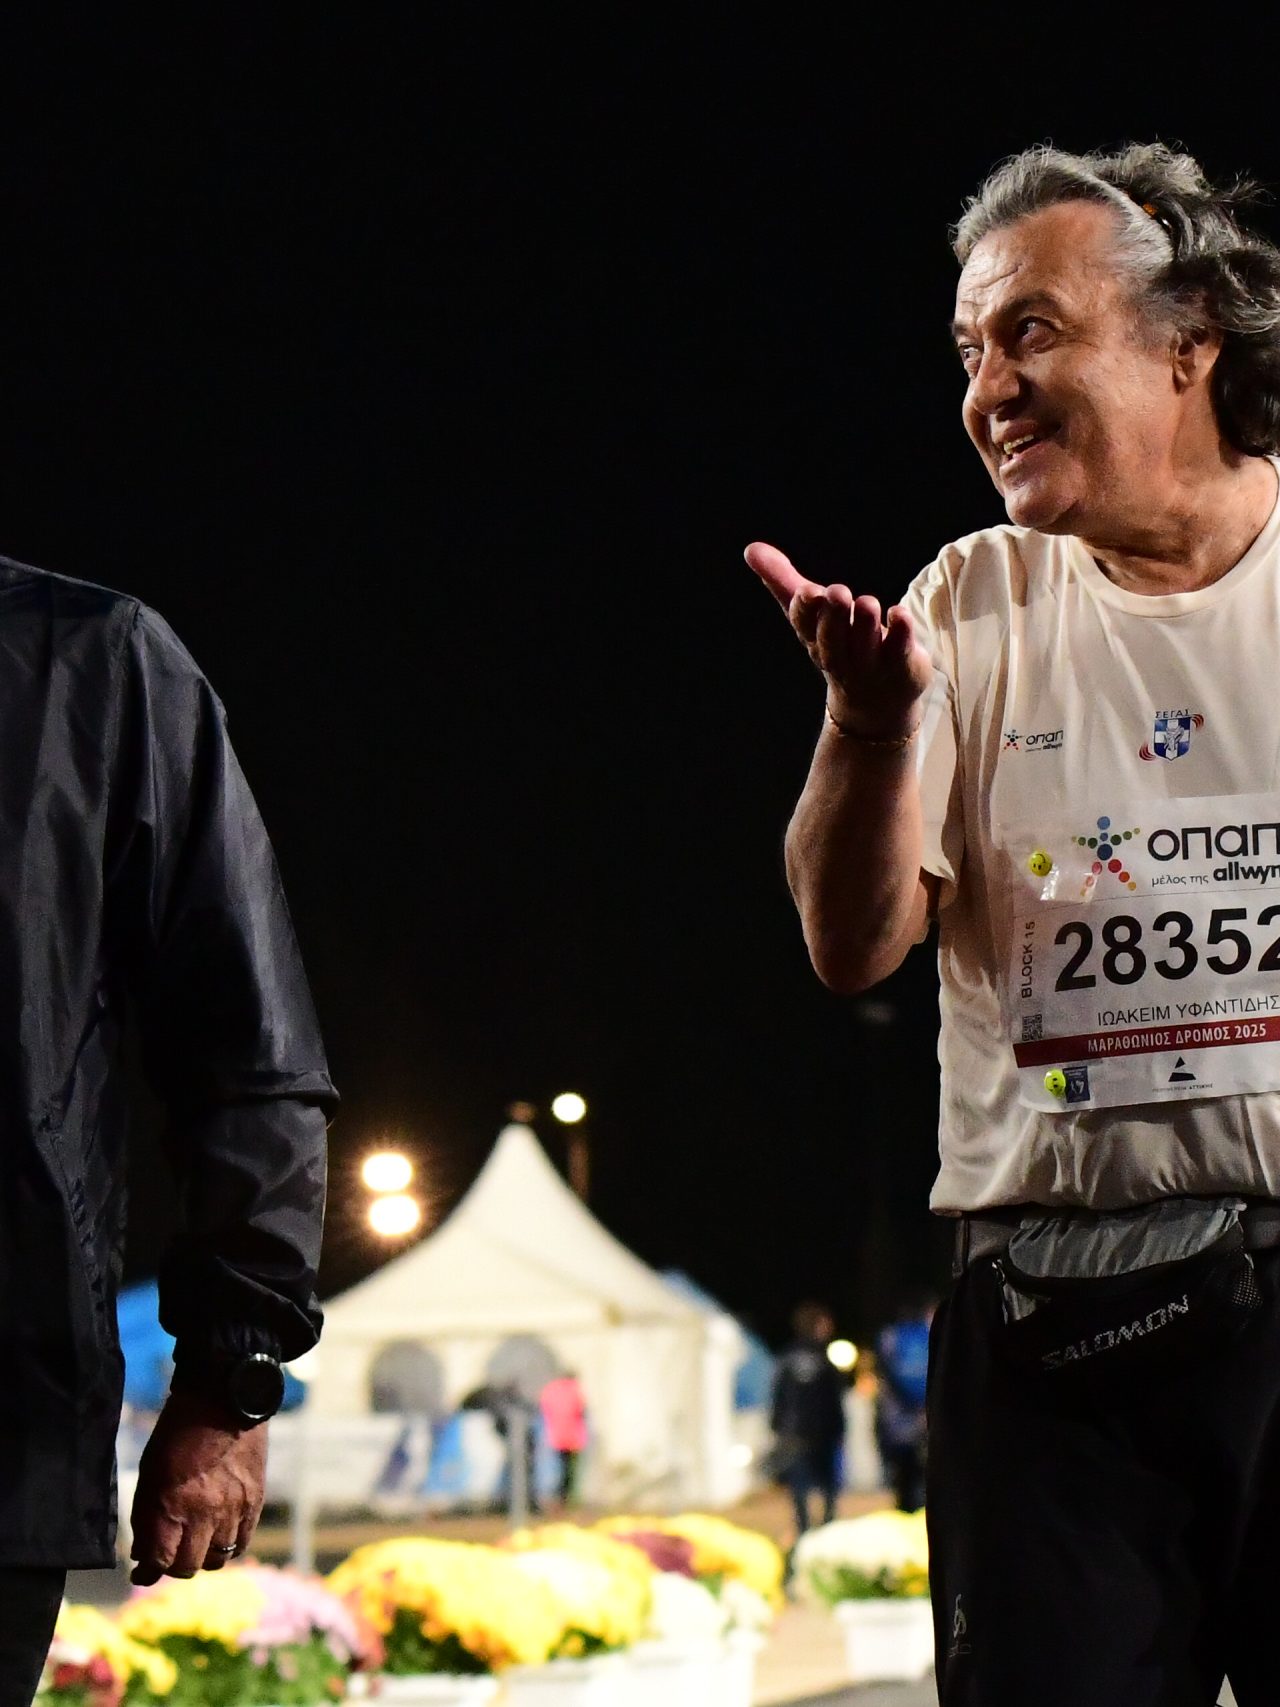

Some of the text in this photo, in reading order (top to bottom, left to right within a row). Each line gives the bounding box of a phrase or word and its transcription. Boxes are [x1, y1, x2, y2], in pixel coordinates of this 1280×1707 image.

[1155, 709, 1190, 719] ΣΕΓΑΣ
[1151, 874, 1188, 888] μέλος
[1189, 874, 1210, 886] της
[1021, 921, 1036, 999] BLOCK 15
[1097, 994, 1280, 1027] ΙΩΑΚΕΙΜ ΥΦΑΝΤΙΔΗΣ
[1087, 1023, 1268, 1053] ΜΑΡΑΘΩΝΙΟΣ ΔΡΟΜΟΣ 2025
[1041, 1294, 1189, 1371] SALOMON
